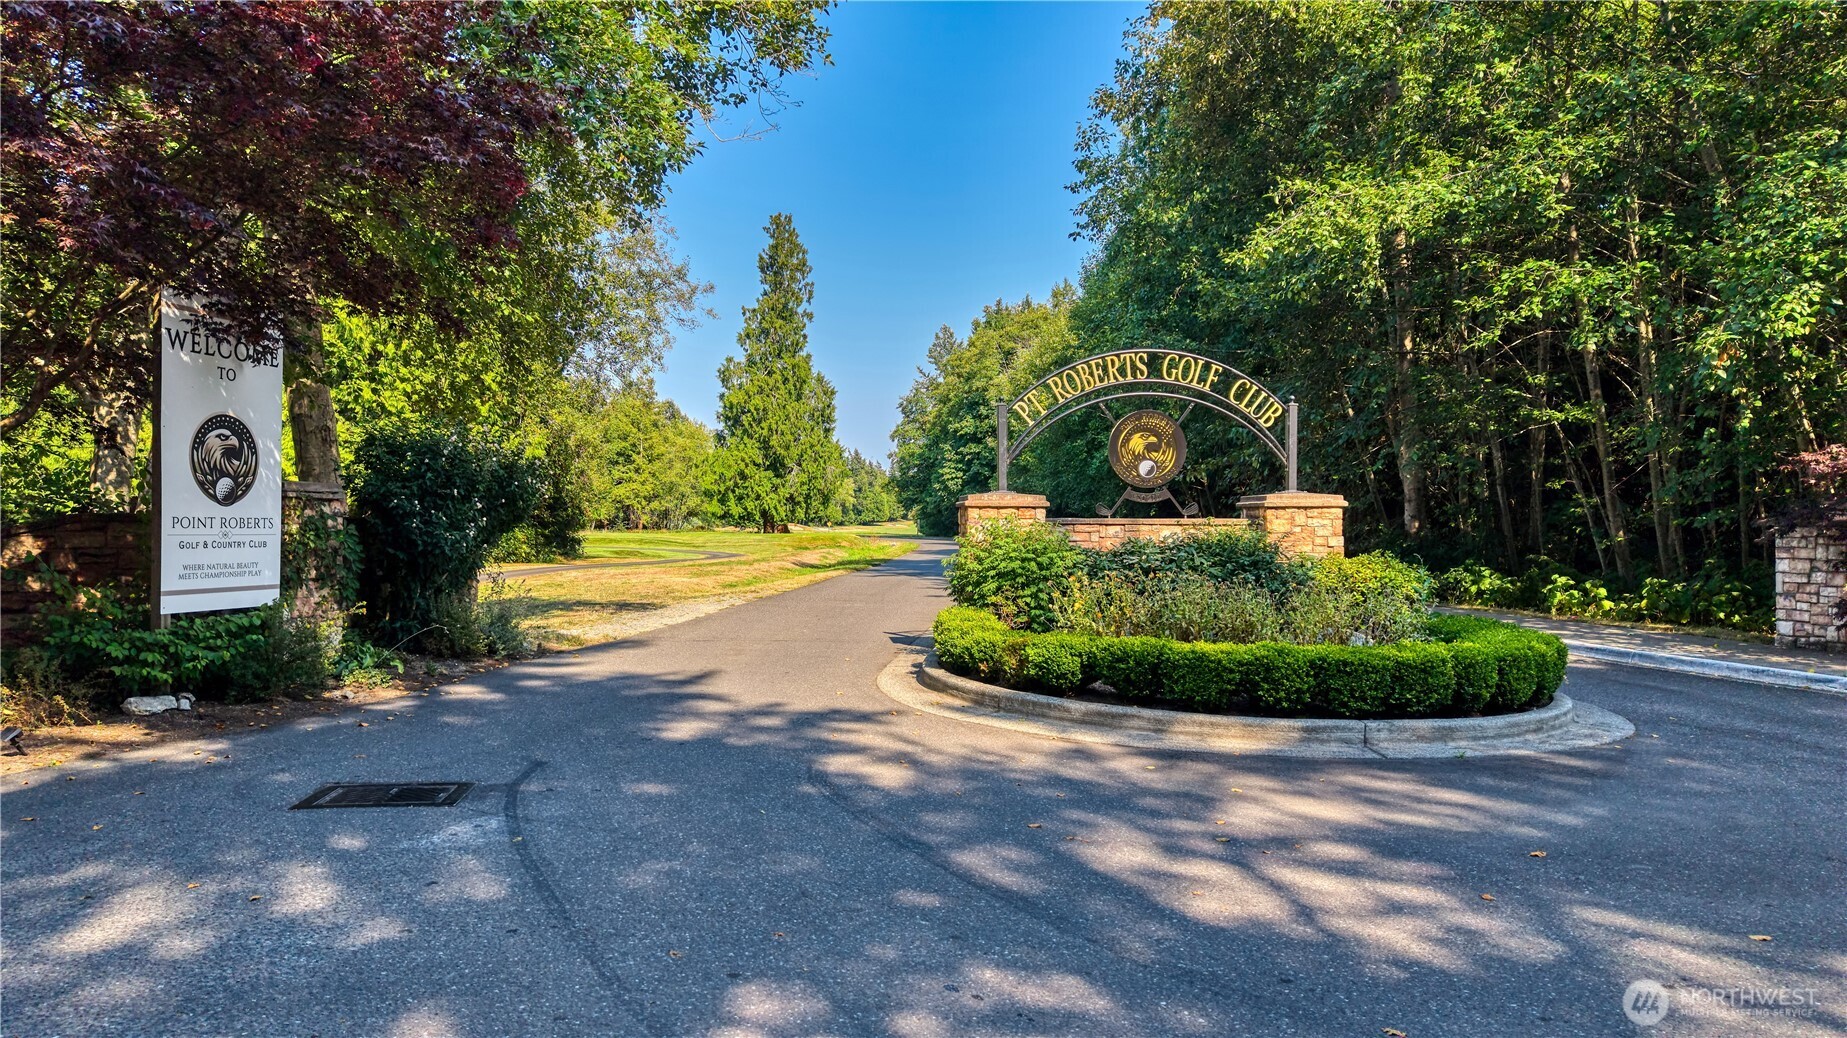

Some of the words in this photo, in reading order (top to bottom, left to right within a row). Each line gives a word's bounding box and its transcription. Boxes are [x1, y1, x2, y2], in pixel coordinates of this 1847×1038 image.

[217, 366, 237, 381] TO
[1012, 389, 1048, 427] PT
[1046, 352, 1149, 404] ROBERTS
[1162, 354, 1223, 391] GOLF
[1229, 379, 1284, 428] CLUB
[172, 516, 216, 529] POINT
[220, 516, 274, 530] ROBERTS
[178, 540, 200, 549] GOLF
[202, 540, 209, 549] &
[211, 540, 246, 549] COUNTRY
[248, 540, 268, 548] CLUB
[206, 562, 235, 570] NATURAL
[200, 570, 247, 579] CHAMPIONSHIP
